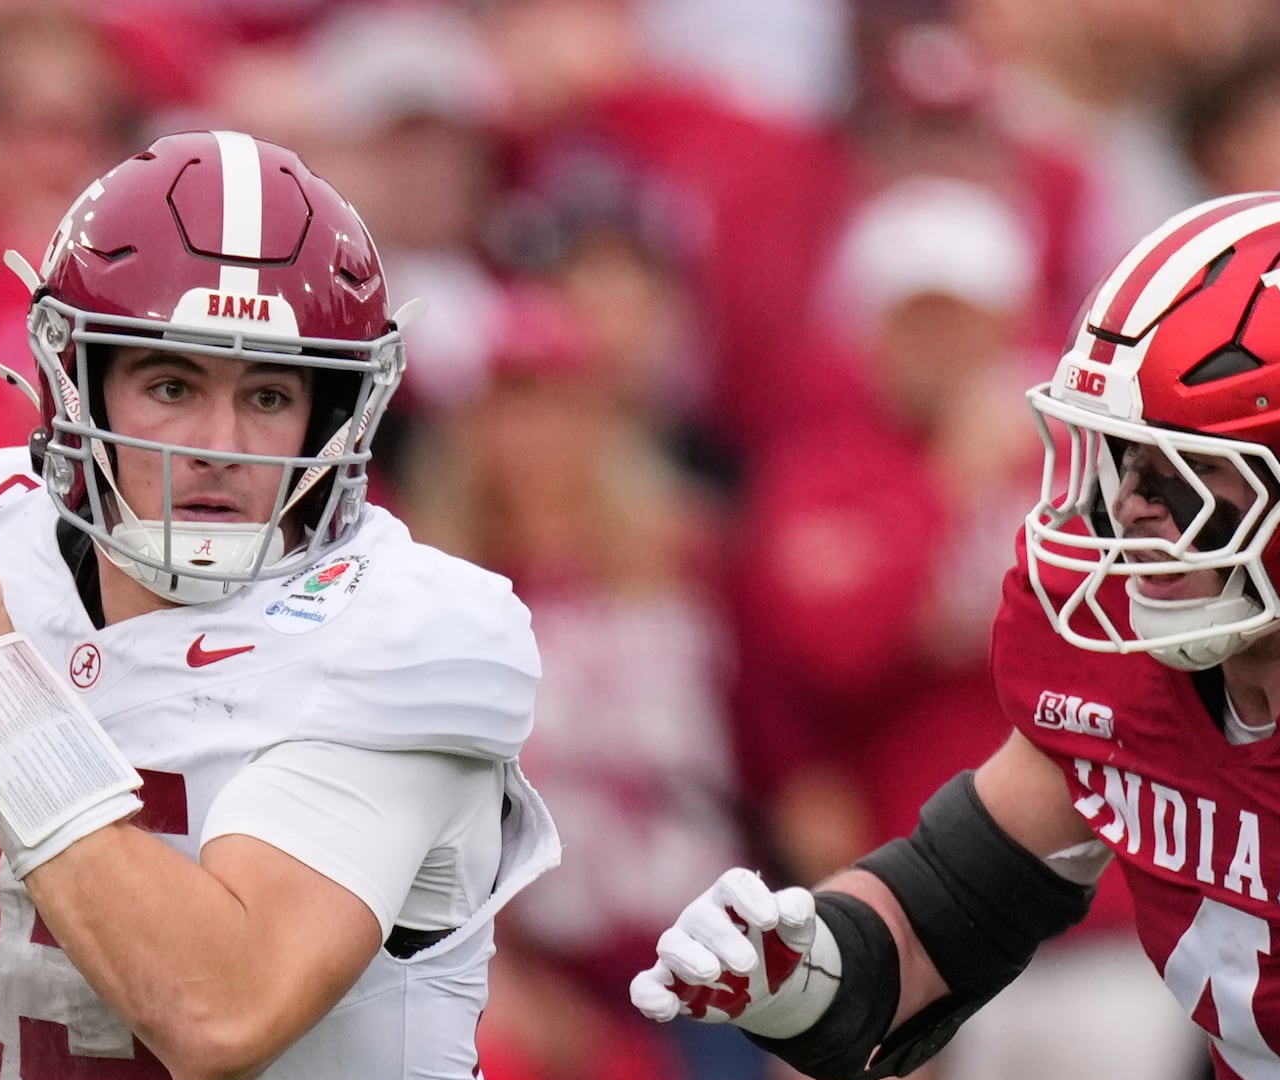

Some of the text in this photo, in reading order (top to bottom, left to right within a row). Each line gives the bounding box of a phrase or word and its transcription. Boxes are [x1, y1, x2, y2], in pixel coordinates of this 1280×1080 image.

[207, 294, 271, 322] BAMA
[54, 368, 81, 423] CRIMSO
[280, 605, 327, 622] Prudential
